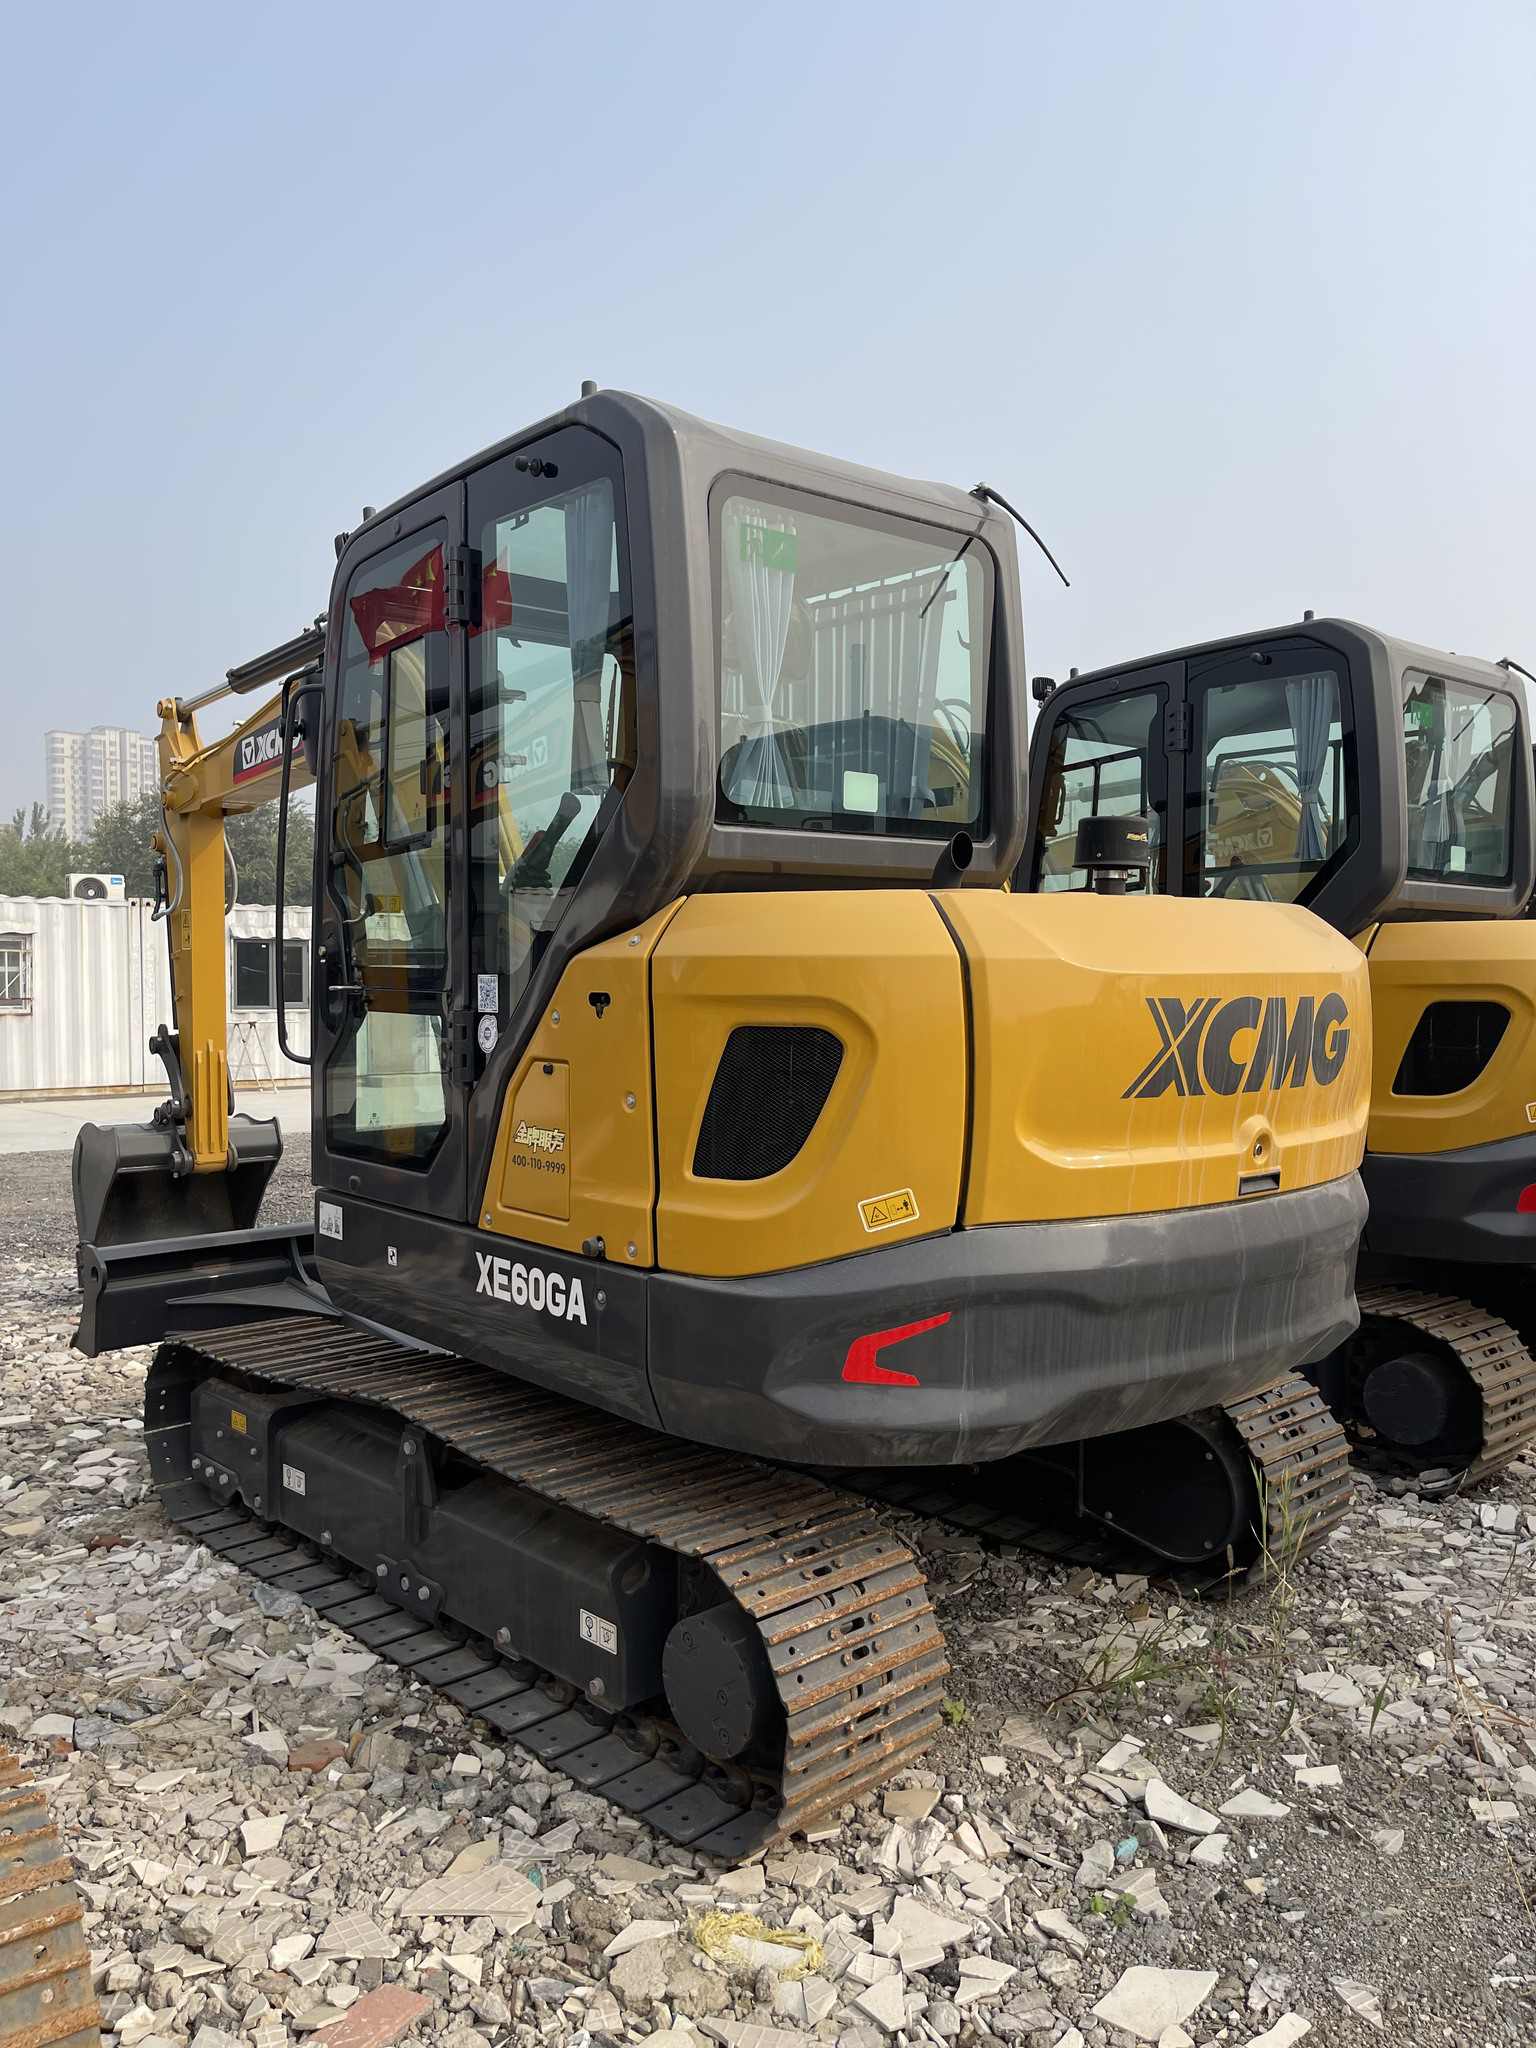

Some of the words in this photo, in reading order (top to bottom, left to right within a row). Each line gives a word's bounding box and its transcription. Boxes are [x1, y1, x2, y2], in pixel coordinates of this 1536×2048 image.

[1120, 992, 1350, 1098] XCMG
[513, 1120, 566, 1153] 金牌服务
[512, 1154, 566, 1174] 400-110-9999
[475, 1251, 587, 1326] XE60GA
